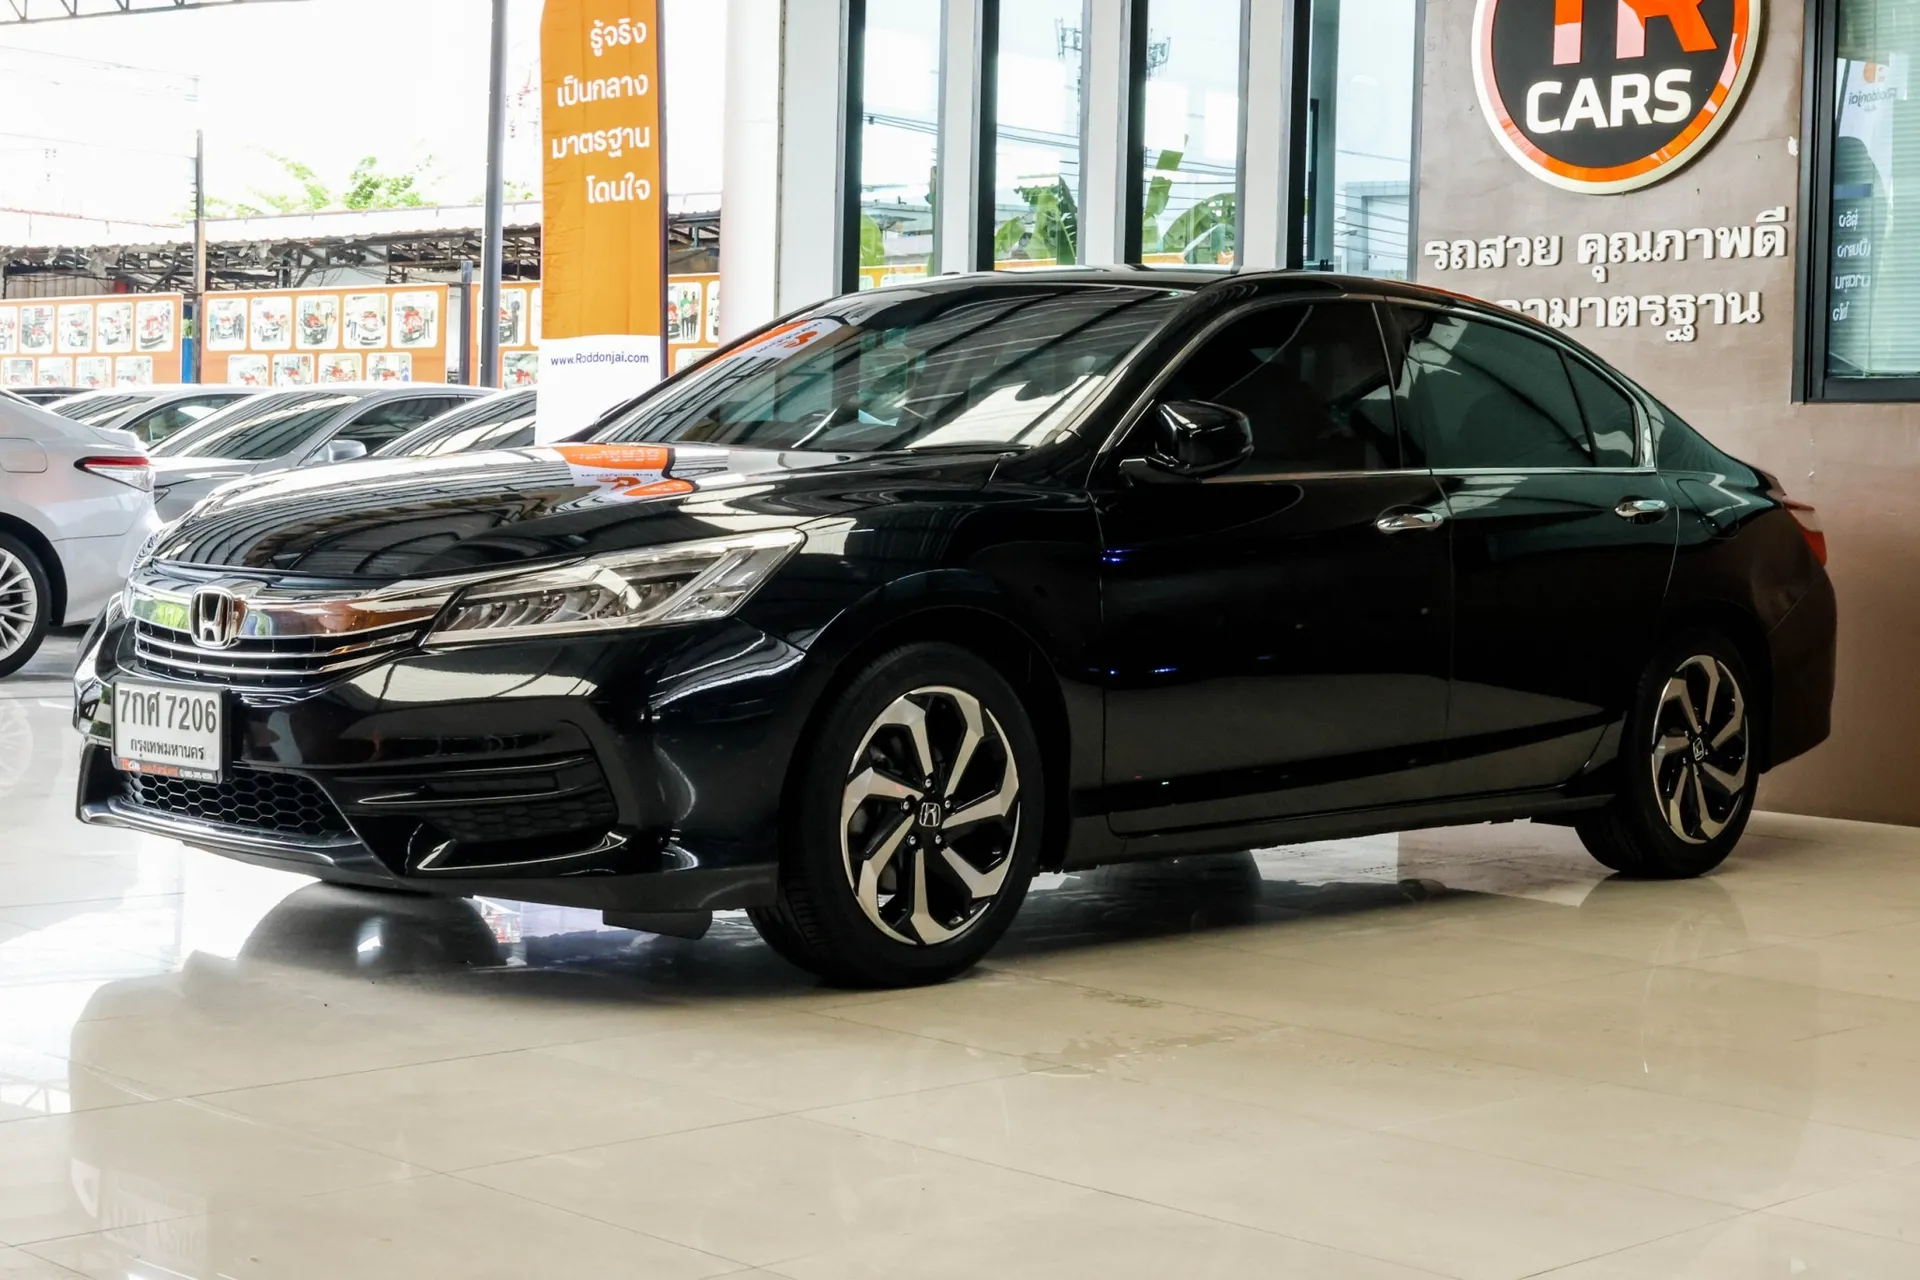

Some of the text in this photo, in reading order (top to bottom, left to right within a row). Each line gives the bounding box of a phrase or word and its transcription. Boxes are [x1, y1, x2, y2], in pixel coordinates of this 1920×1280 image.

[589, 17, 647, 57] รู้จริง
[557, 74, 649, 107] เป็นกลาง
[1525, 68, 1692, 134] CARS
[552, 126, 650, 159] มาตรฐาน
[586, 172, 650, 204] โดนใจ
[1424, 206, 1789, 283] รถสวย คุณภาพดี
[550, 351, 649, 366] www.Roddonjai.com
[165, 694, 217, 734] 7206
[130, 737, 205, 761] กรุงเทพมหานคร
